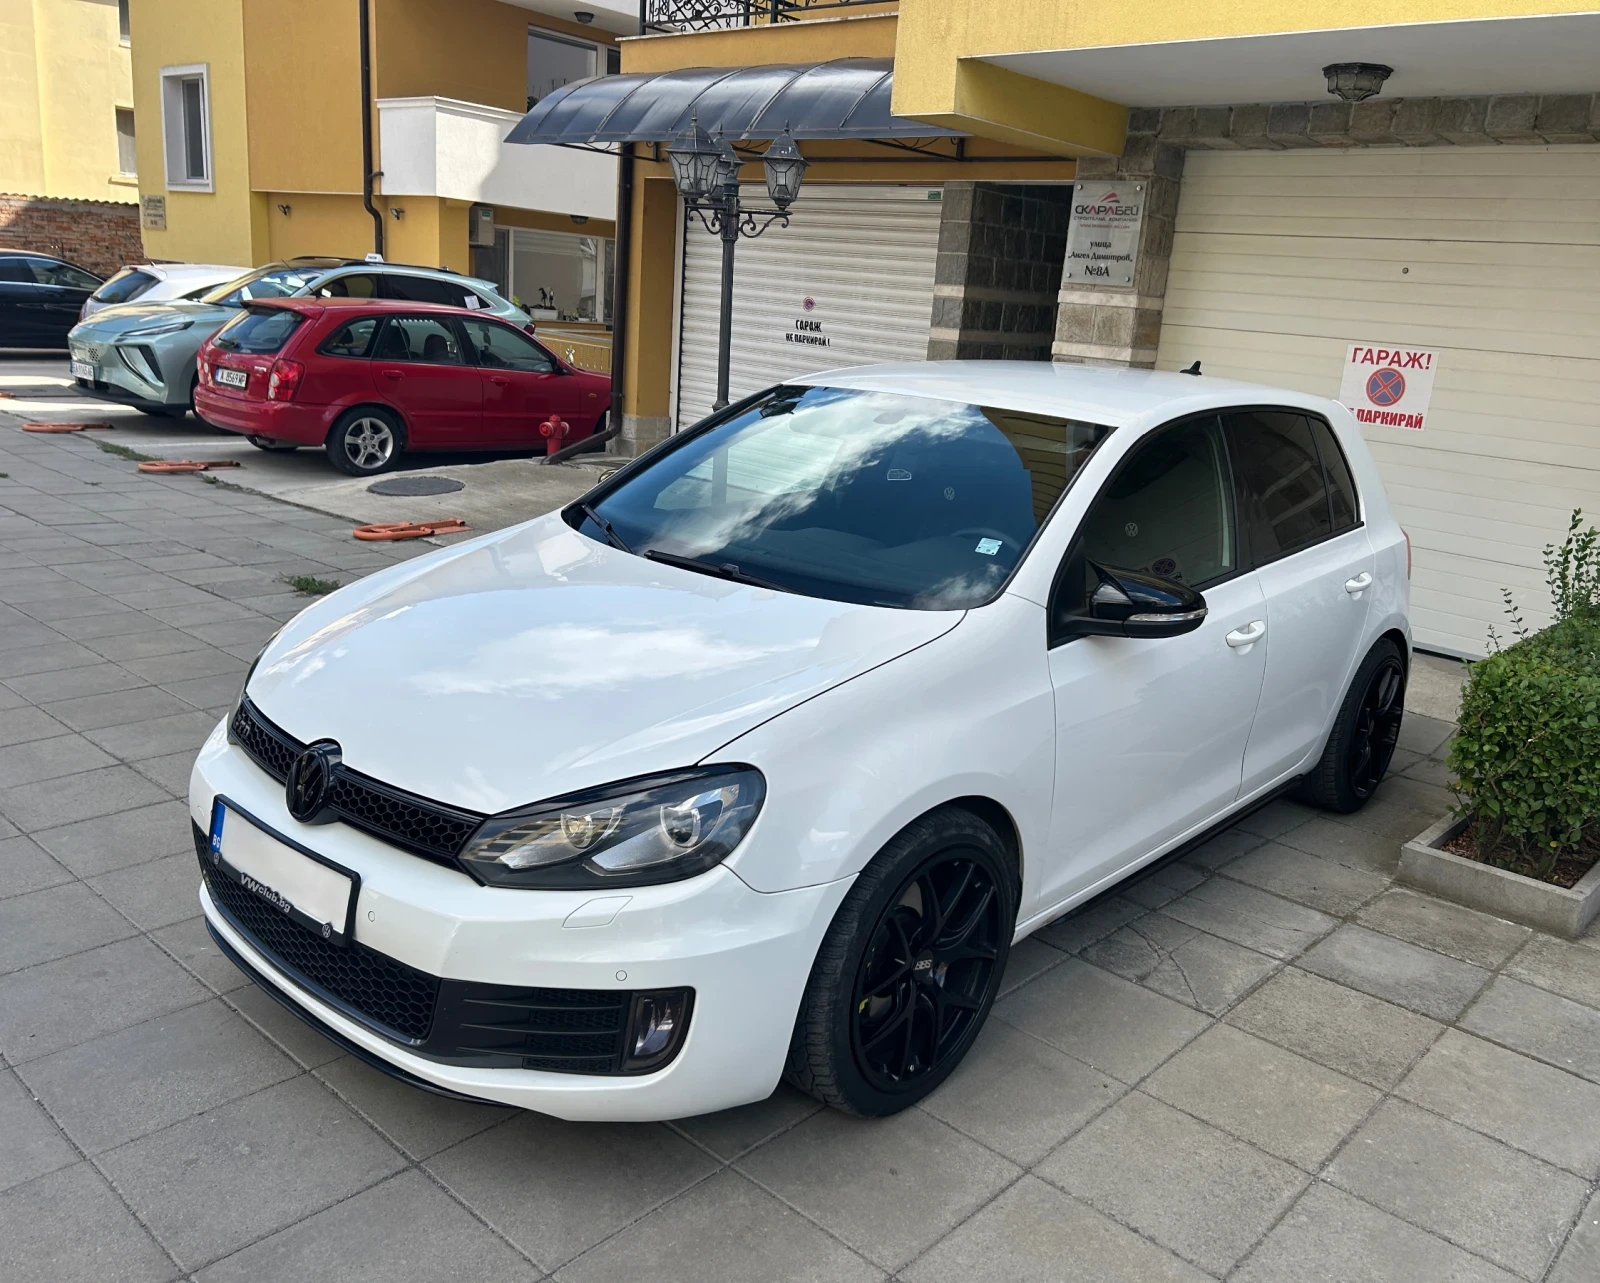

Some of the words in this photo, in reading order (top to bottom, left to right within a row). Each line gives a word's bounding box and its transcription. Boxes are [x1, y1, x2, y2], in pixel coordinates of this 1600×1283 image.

[1090, 241, 1112, 250] улица
[795, 319, 822, 332] ГАРАЖ
[785, 333, 794, 342] НЕ
[1351, 347, 1432, 370] ГАРАЖ!
[1356, 408, 1424, 430] ПАРКИРАЙ
[240, 874, 291, 913] VWclub.bg
[914, 959, 932, 970] BBS
